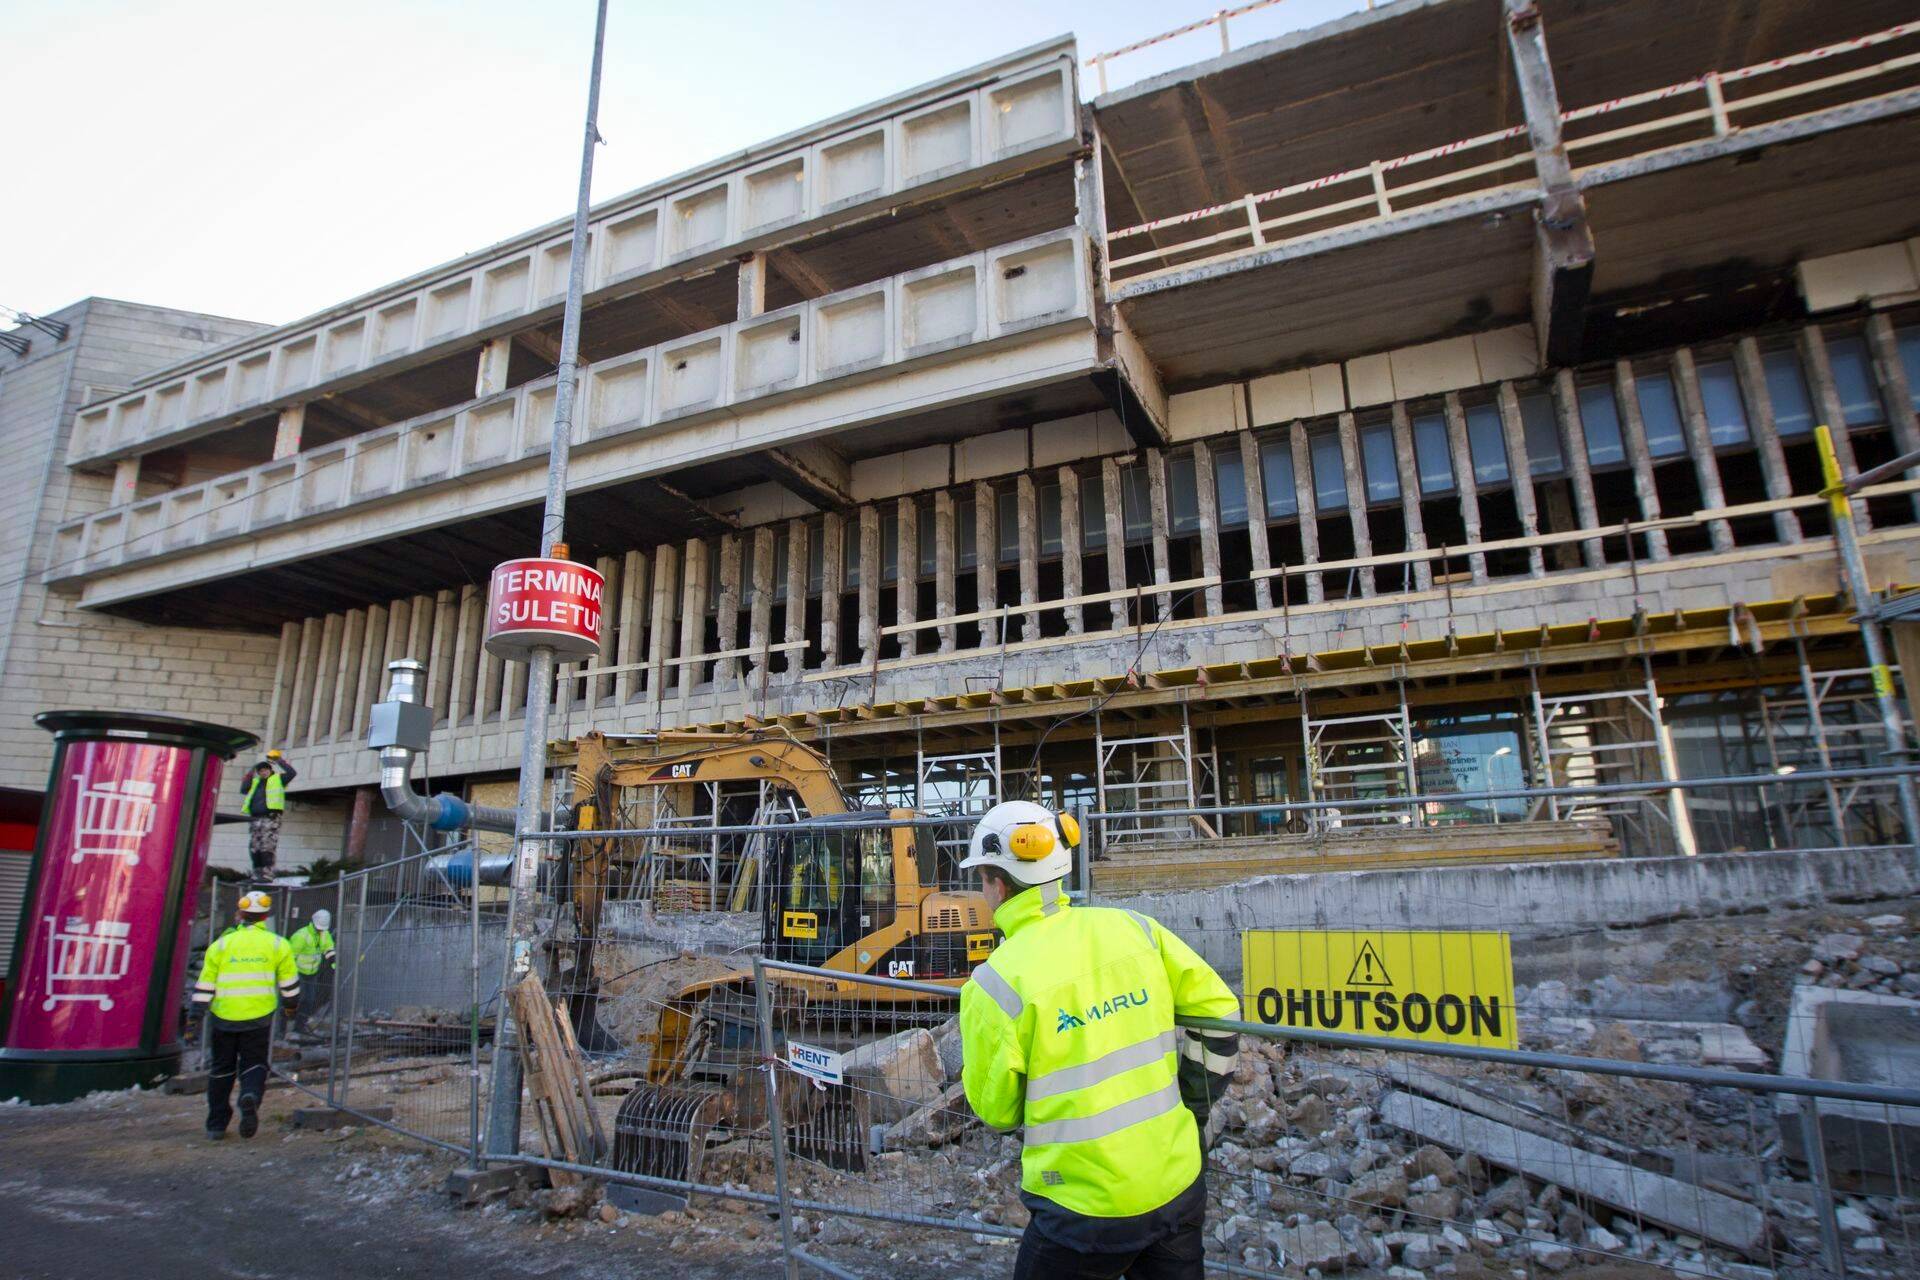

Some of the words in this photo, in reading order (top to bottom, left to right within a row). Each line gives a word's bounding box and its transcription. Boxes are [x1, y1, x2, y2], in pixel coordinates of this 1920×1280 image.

[497, 569, 603, 605] TERMINA
[672, 764, 692, 778] CAT
[888, 960, 915, 978] CAT
[1085, 988, 1149, 1021] MARU
[1257, 986, 1502, 1037] OHUTSOON
